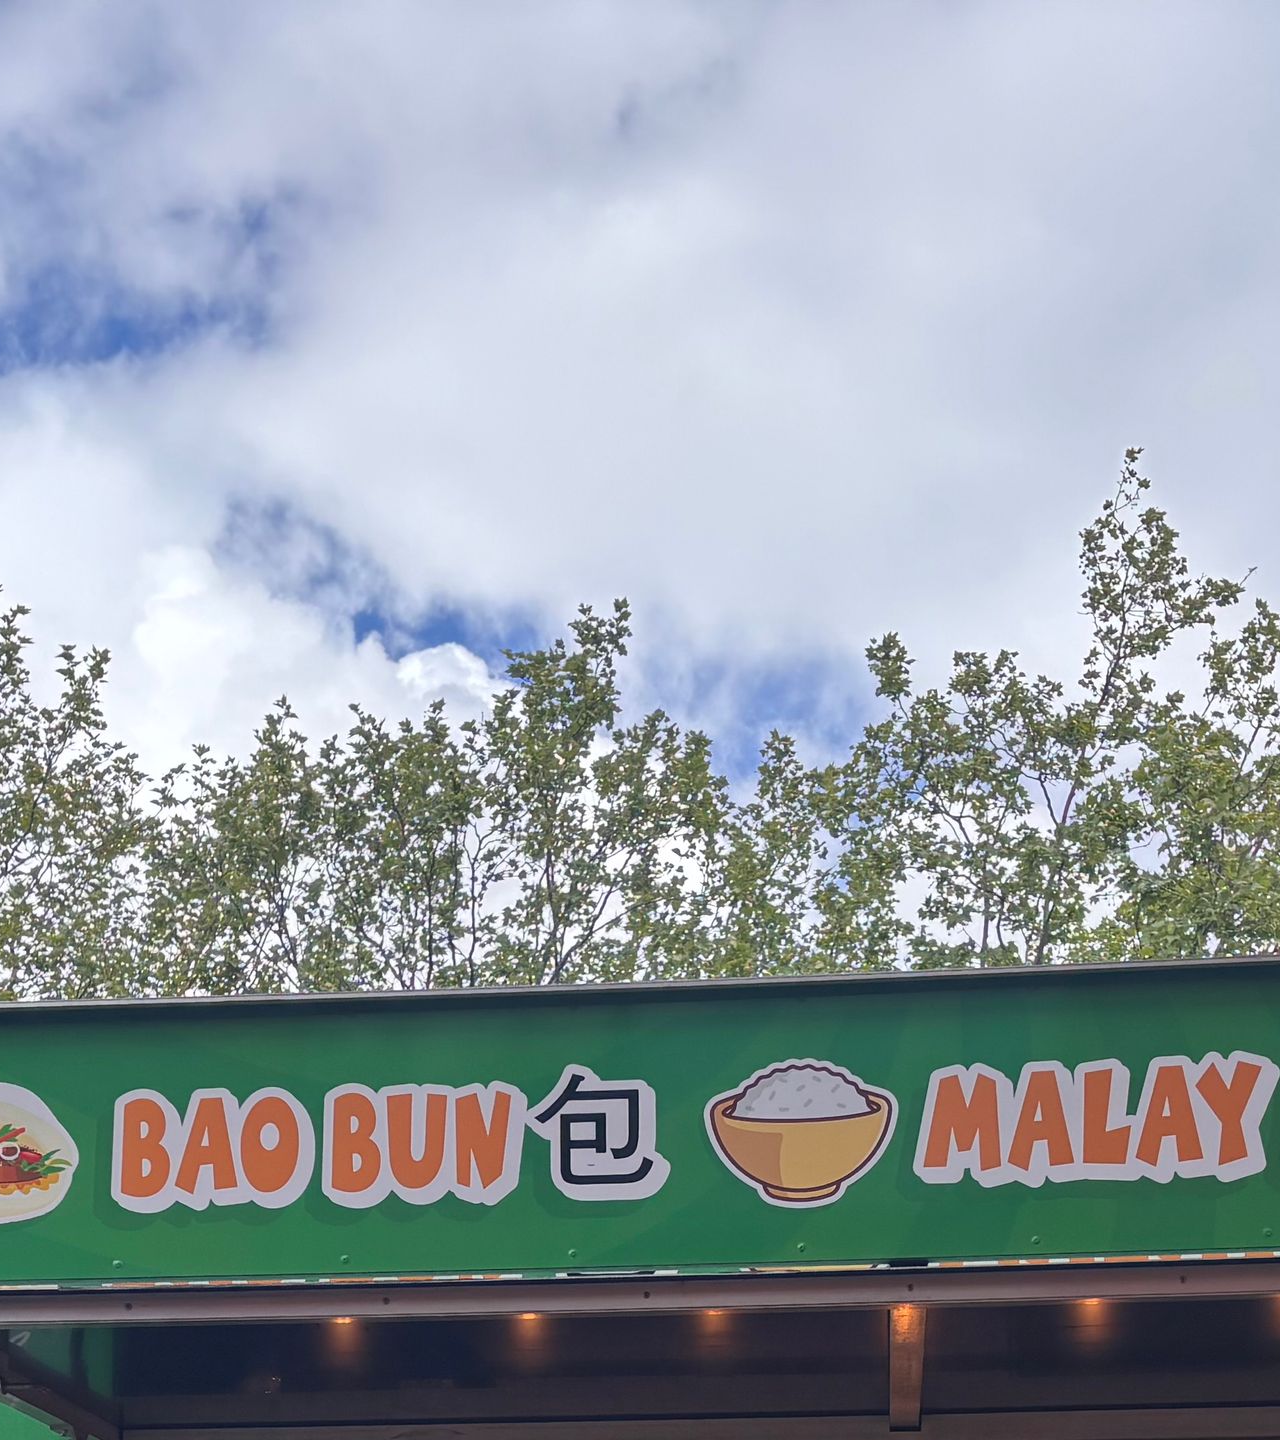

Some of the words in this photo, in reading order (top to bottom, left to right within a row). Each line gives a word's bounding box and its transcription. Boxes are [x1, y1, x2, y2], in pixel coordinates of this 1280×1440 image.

[119, 1094, 302, 1202] BAO
[329, 1088, 512, 1194] BUN
[533, 1071, 654, 1186] 包
[922, 1059, 1264, 1170] MALAY
